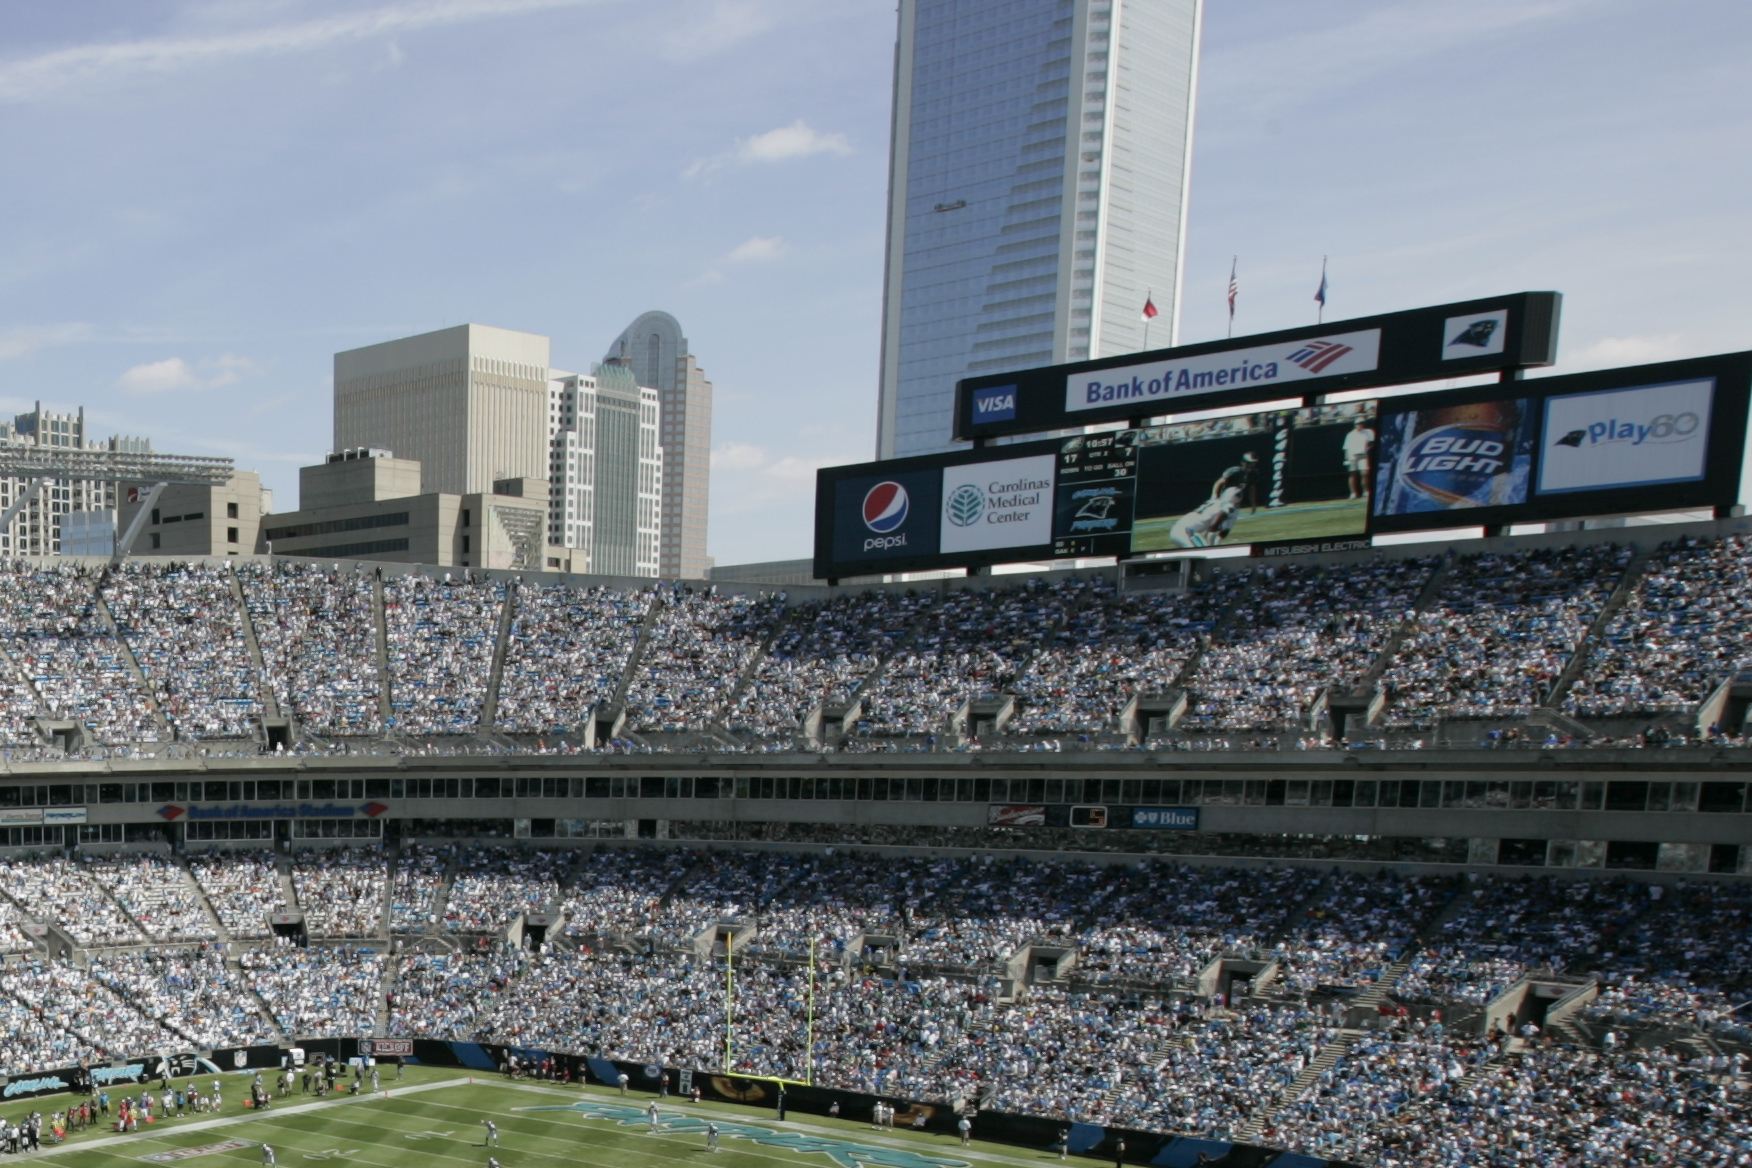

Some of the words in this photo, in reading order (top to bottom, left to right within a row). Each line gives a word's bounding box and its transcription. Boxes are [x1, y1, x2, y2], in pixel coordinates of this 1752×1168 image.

[1086, 376, 1145, 404] Bank
[1148, 371, 1174, 395] of
[1175, 359, 1279, 392] America
[977, 394, 1015, 413] VISA
[1588, 412, 1699, 447] Play60
[1124, 447, 1132, 457] 7
[1421, 436, 1504, 456] BUD
[1064, 453, 1078, 464] 17
[1403, 456, 1504, 475] LIGHT
[1114, 468, 1128, 478] 30
[988, 477, 1050, 495] Carolinas
[987, 492, 1040, 509] Medical
[987, 510, 1031, 524] Center
[864, 533, 908, 552] pepsi
[1264, 543, 1319, 556] MITSUBISHI
[1321, 540, 1370, 552] ELECTRIC
[241, 804, 296, 818] America
[299, 803, 355, 817] Stadium
[1160, 812, 1196, 825] Blue
